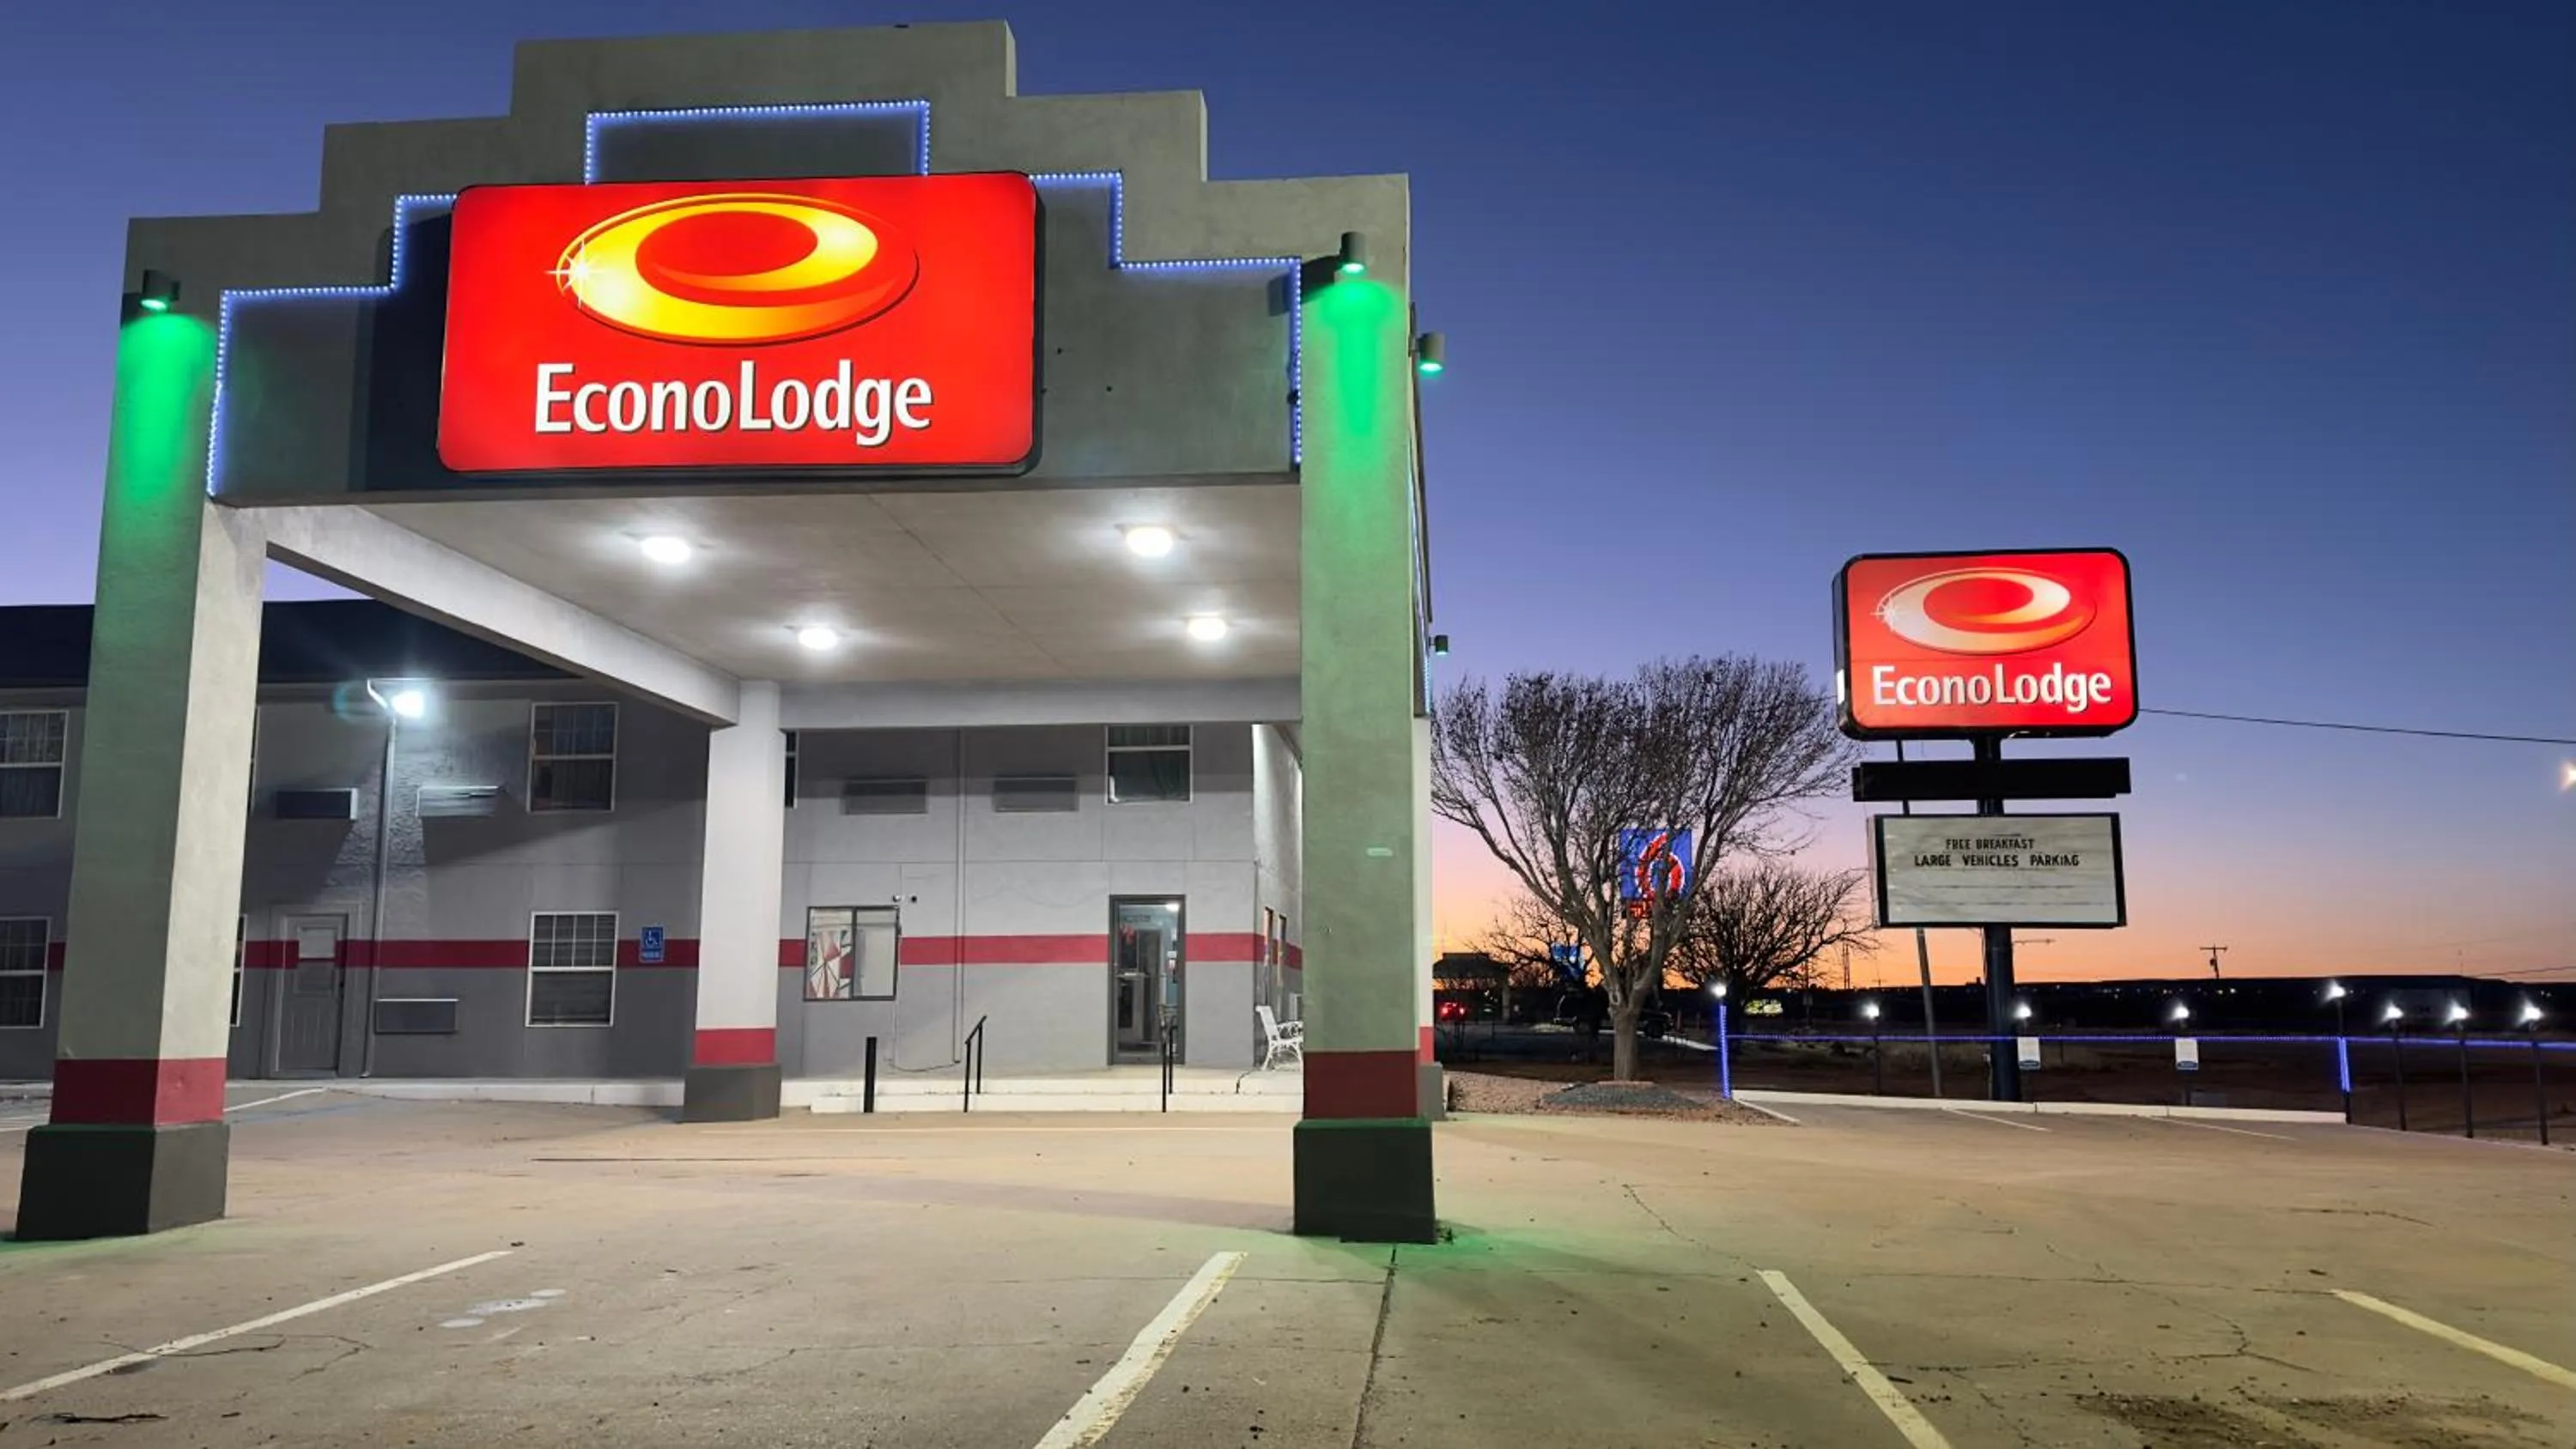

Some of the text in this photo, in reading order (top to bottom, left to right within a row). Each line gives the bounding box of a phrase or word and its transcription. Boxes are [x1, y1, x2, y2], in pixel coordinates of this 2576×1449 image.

[535, 360, 933, 446] EconoLodge
[1872, 663, 2111, 713] EconoLodge
[1946, 839, 2035, 850] FREE BREAKFAST
[1914, 854, 2079, 867] LARGE VEHICLES PARKING
